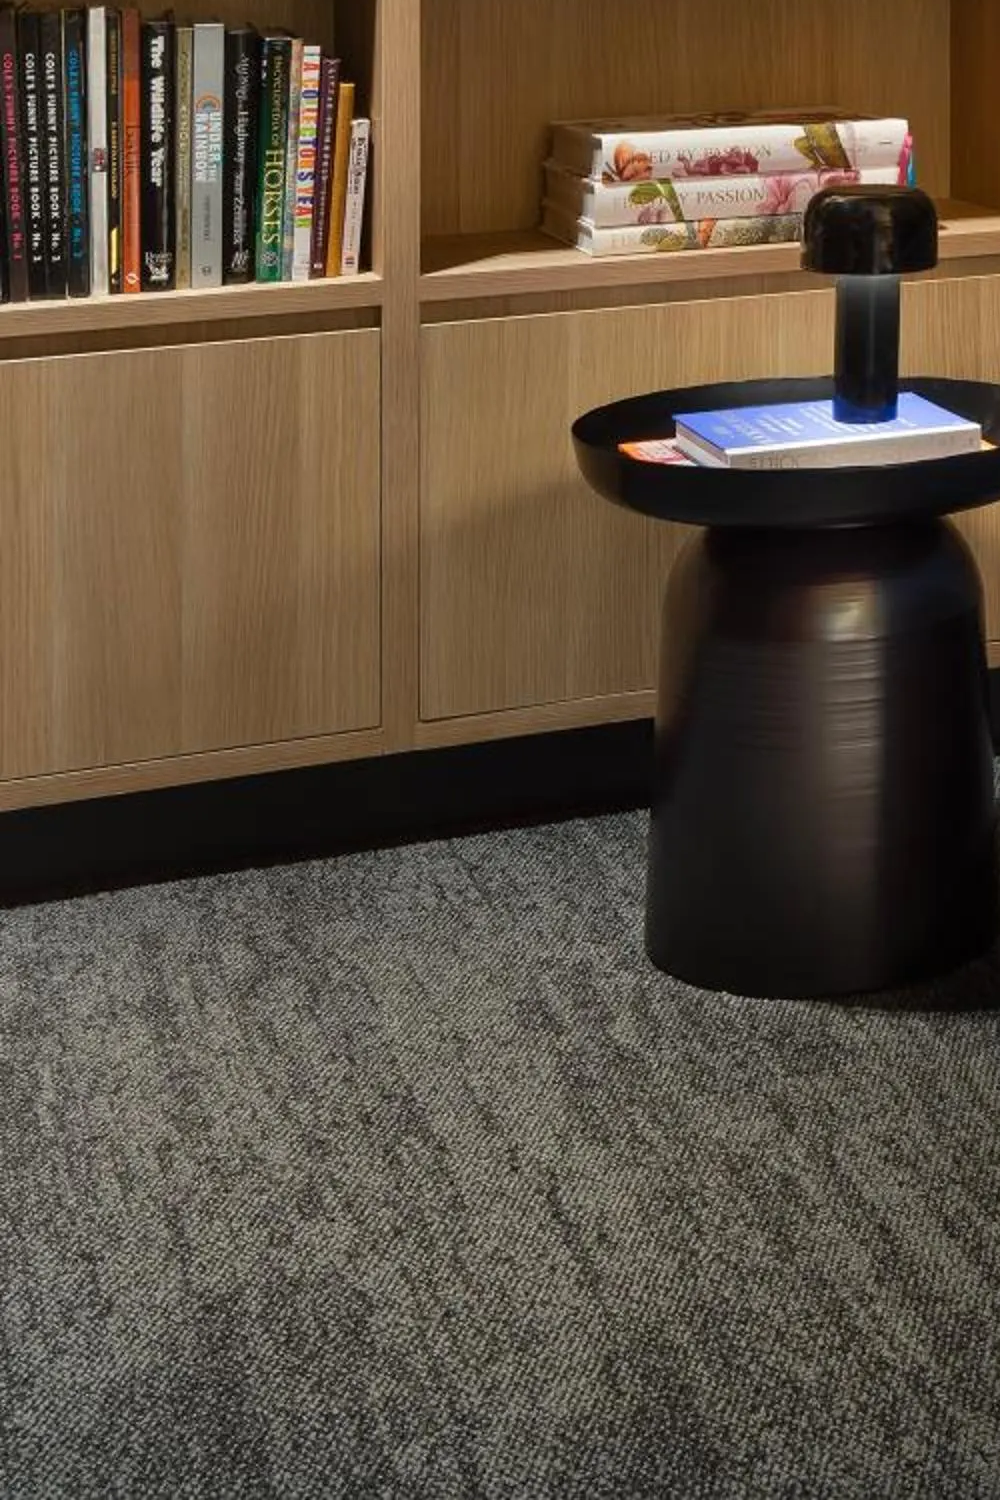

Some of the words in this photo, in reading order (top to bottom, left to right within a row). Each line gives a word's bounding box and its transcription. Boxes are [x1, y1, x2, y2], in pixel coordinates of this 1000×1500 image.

[150, 35, 166, 69] The
[150, 75, 171, 143] Wildlife
[28, 136, 40, 183] PICTURE
[48, 136, 60, 183] PICTURE
[194, 112, 209, 182] RAINBOW
[208, 111, 223, 161] UNDER
[150, 147, 166, 188] Year
[31, 186, 41, 219] BOOK
[49, 186, 60, 219] BOOK
[261, 149, 284, 246] HORSES
[697, 188, 764, 206] PASSION
